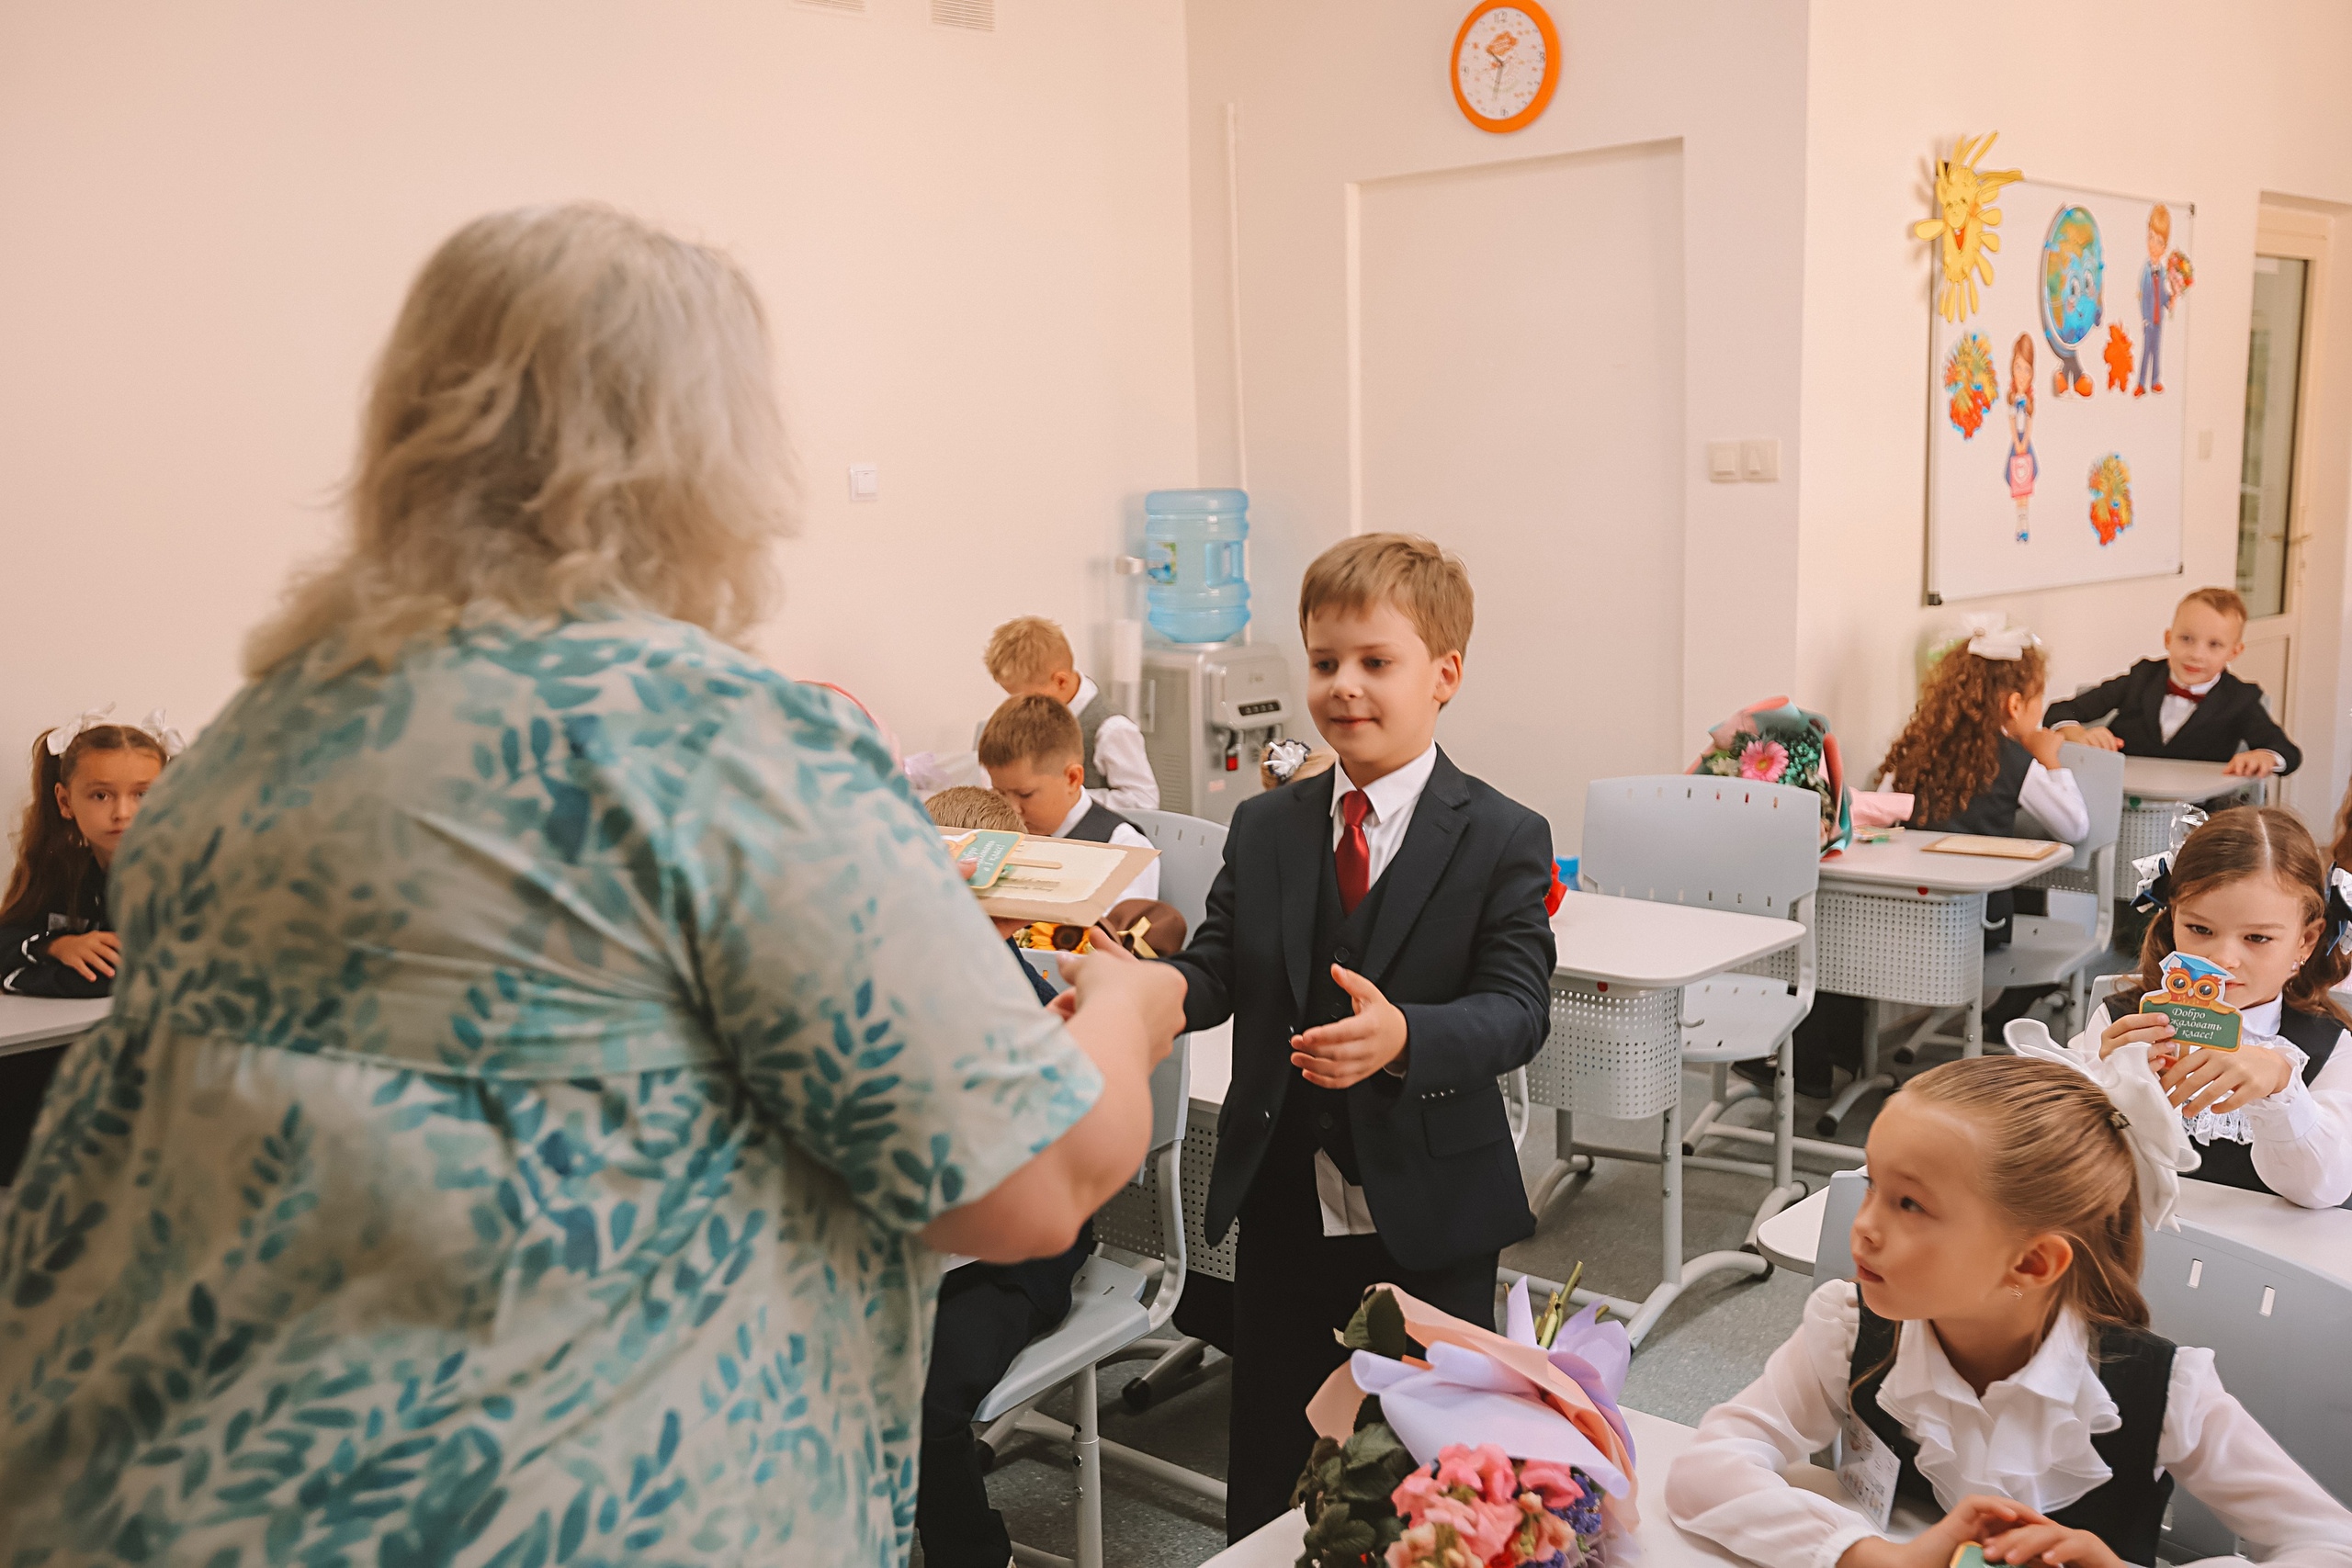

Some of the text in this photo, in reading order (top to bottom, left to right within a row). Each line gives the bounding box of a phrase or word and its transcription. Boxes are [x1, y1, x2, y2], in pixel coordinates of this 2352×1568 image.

[2172, 1008, 2206, 1021] Добро
[2170, 1018, 2222, 1031] жаловать
[2182, 1030, 2214, 1039] класс!
